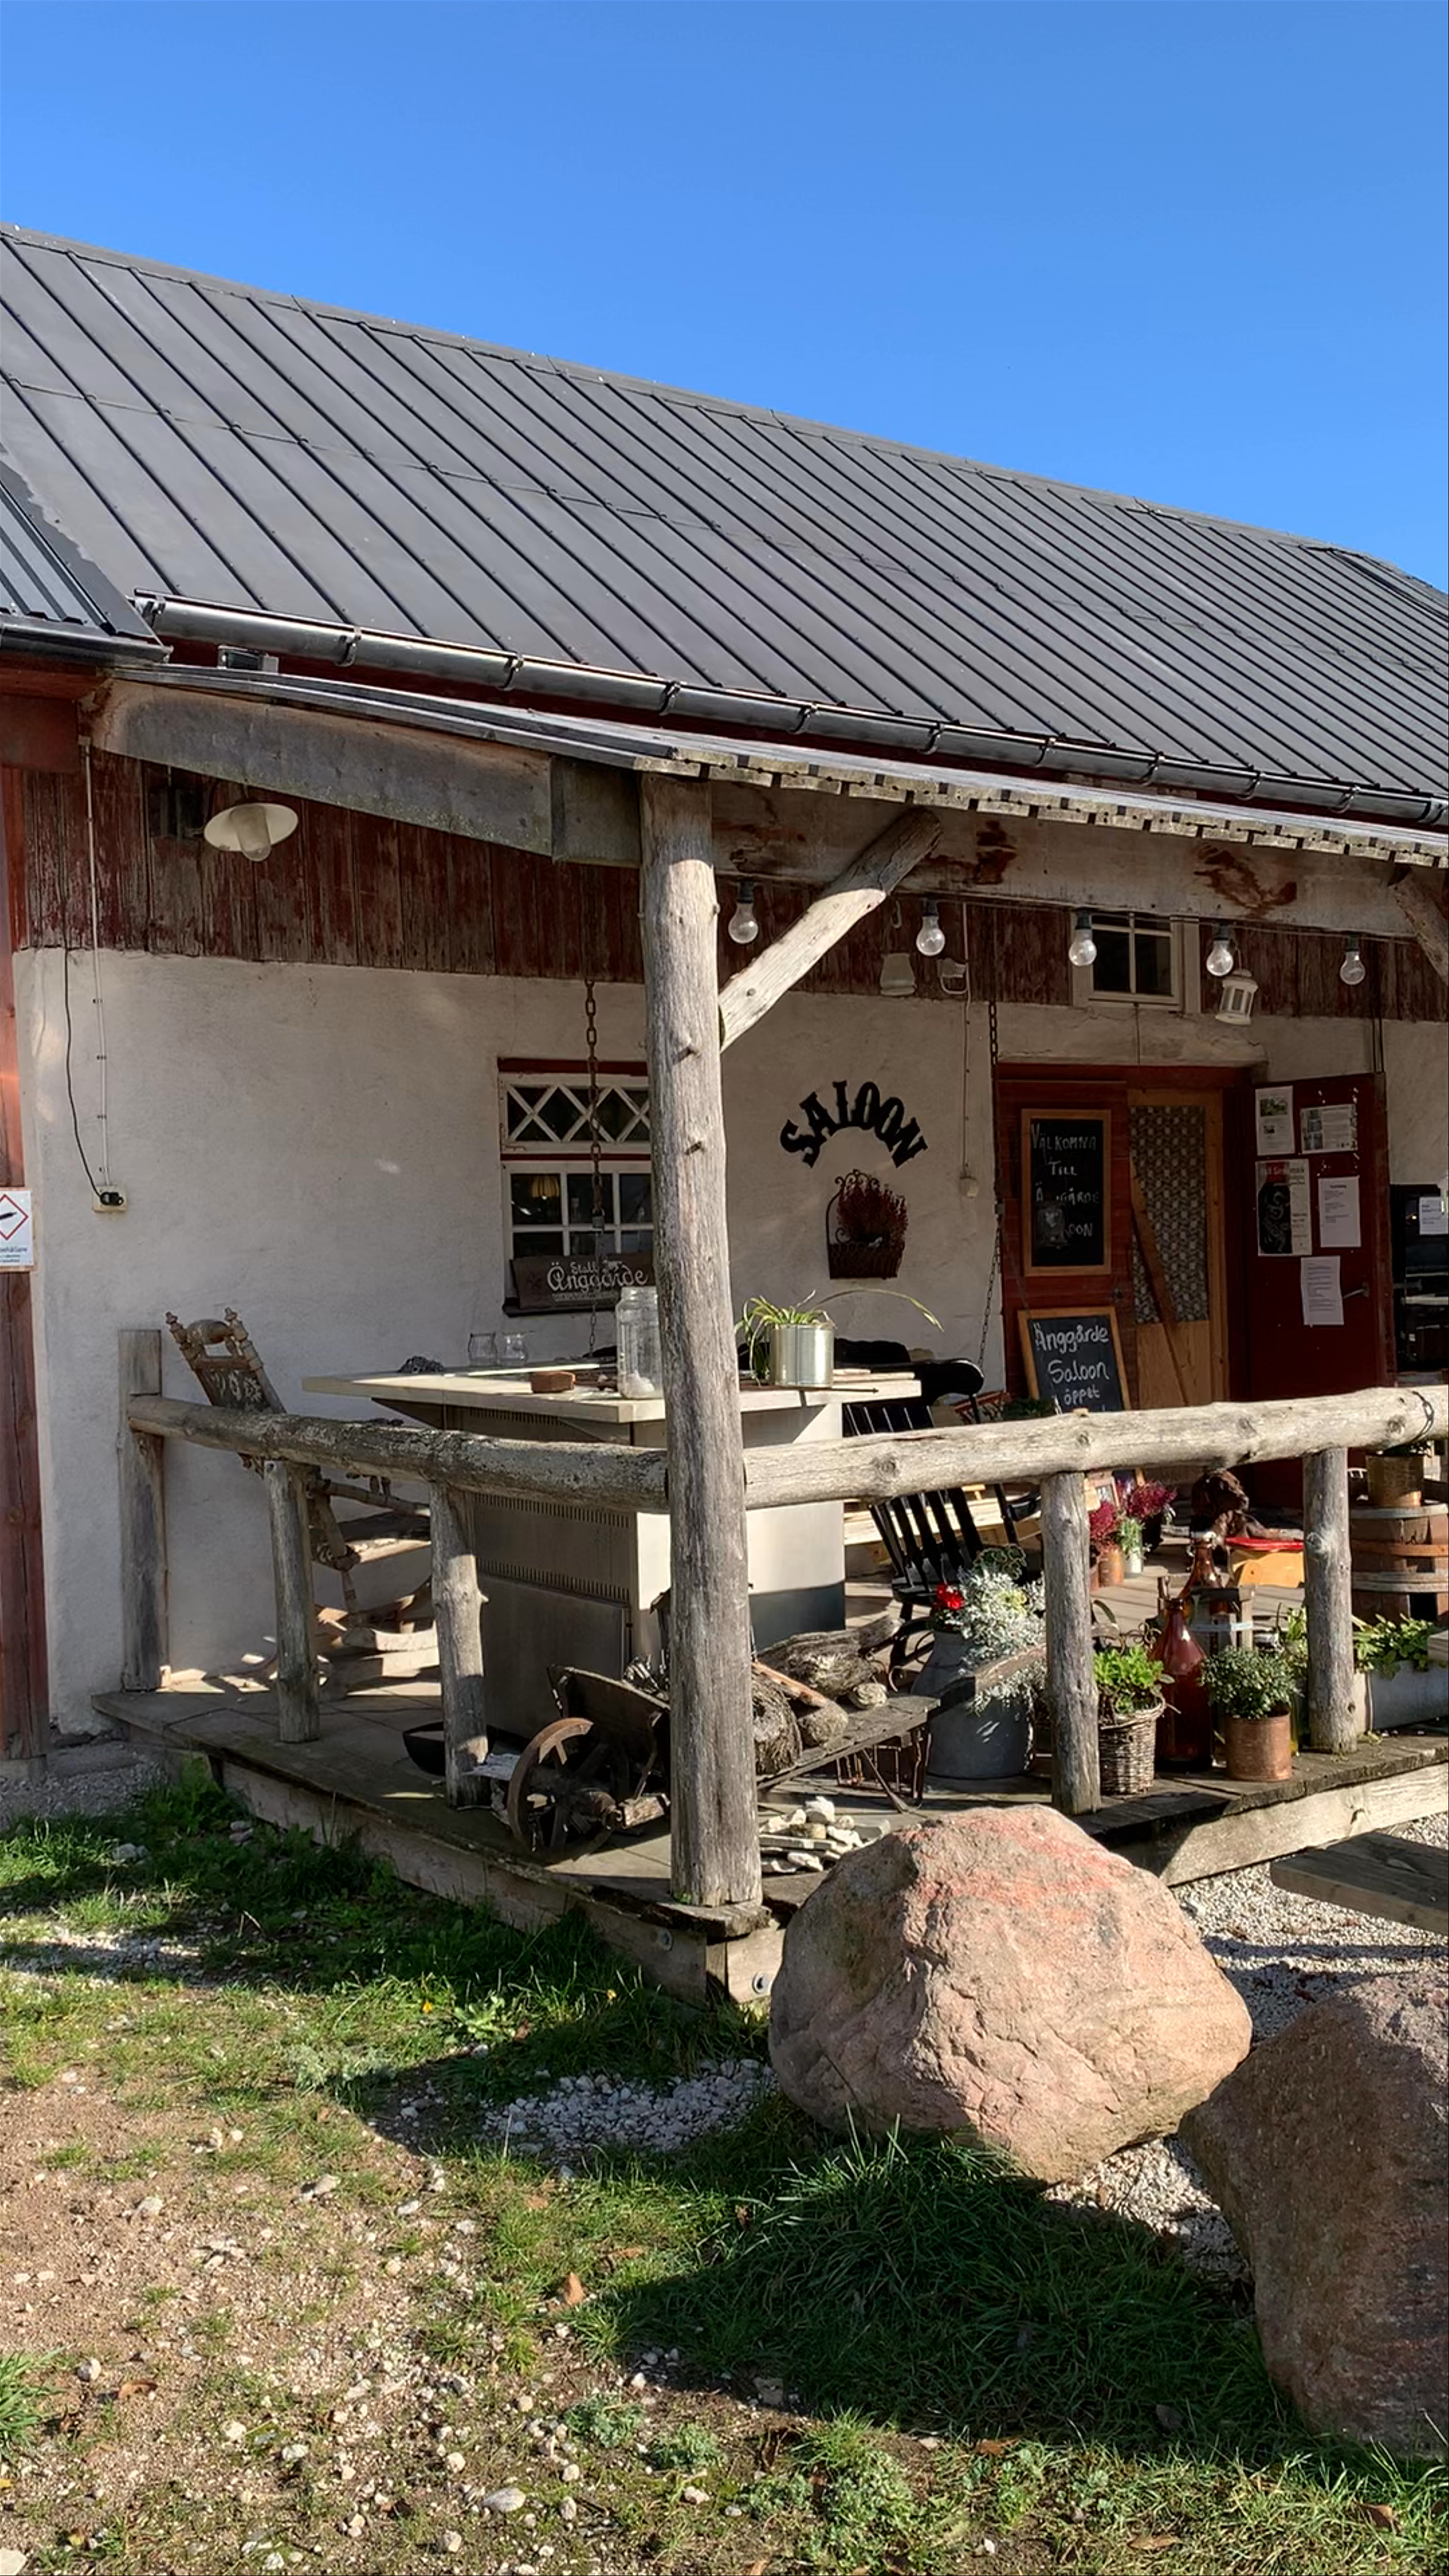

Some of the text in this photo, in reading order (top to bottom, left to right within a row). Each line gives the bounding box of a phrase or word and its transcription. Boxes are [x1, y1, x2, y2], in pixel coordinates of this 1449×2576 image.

[780, 1080, 928, 1168] SALOON
[1034, 1322, 1109, 1354] Änggårde
[1048, 1360, 1109, 1383] Saloon
[1064, 1384, 1100, 1406] öppet
